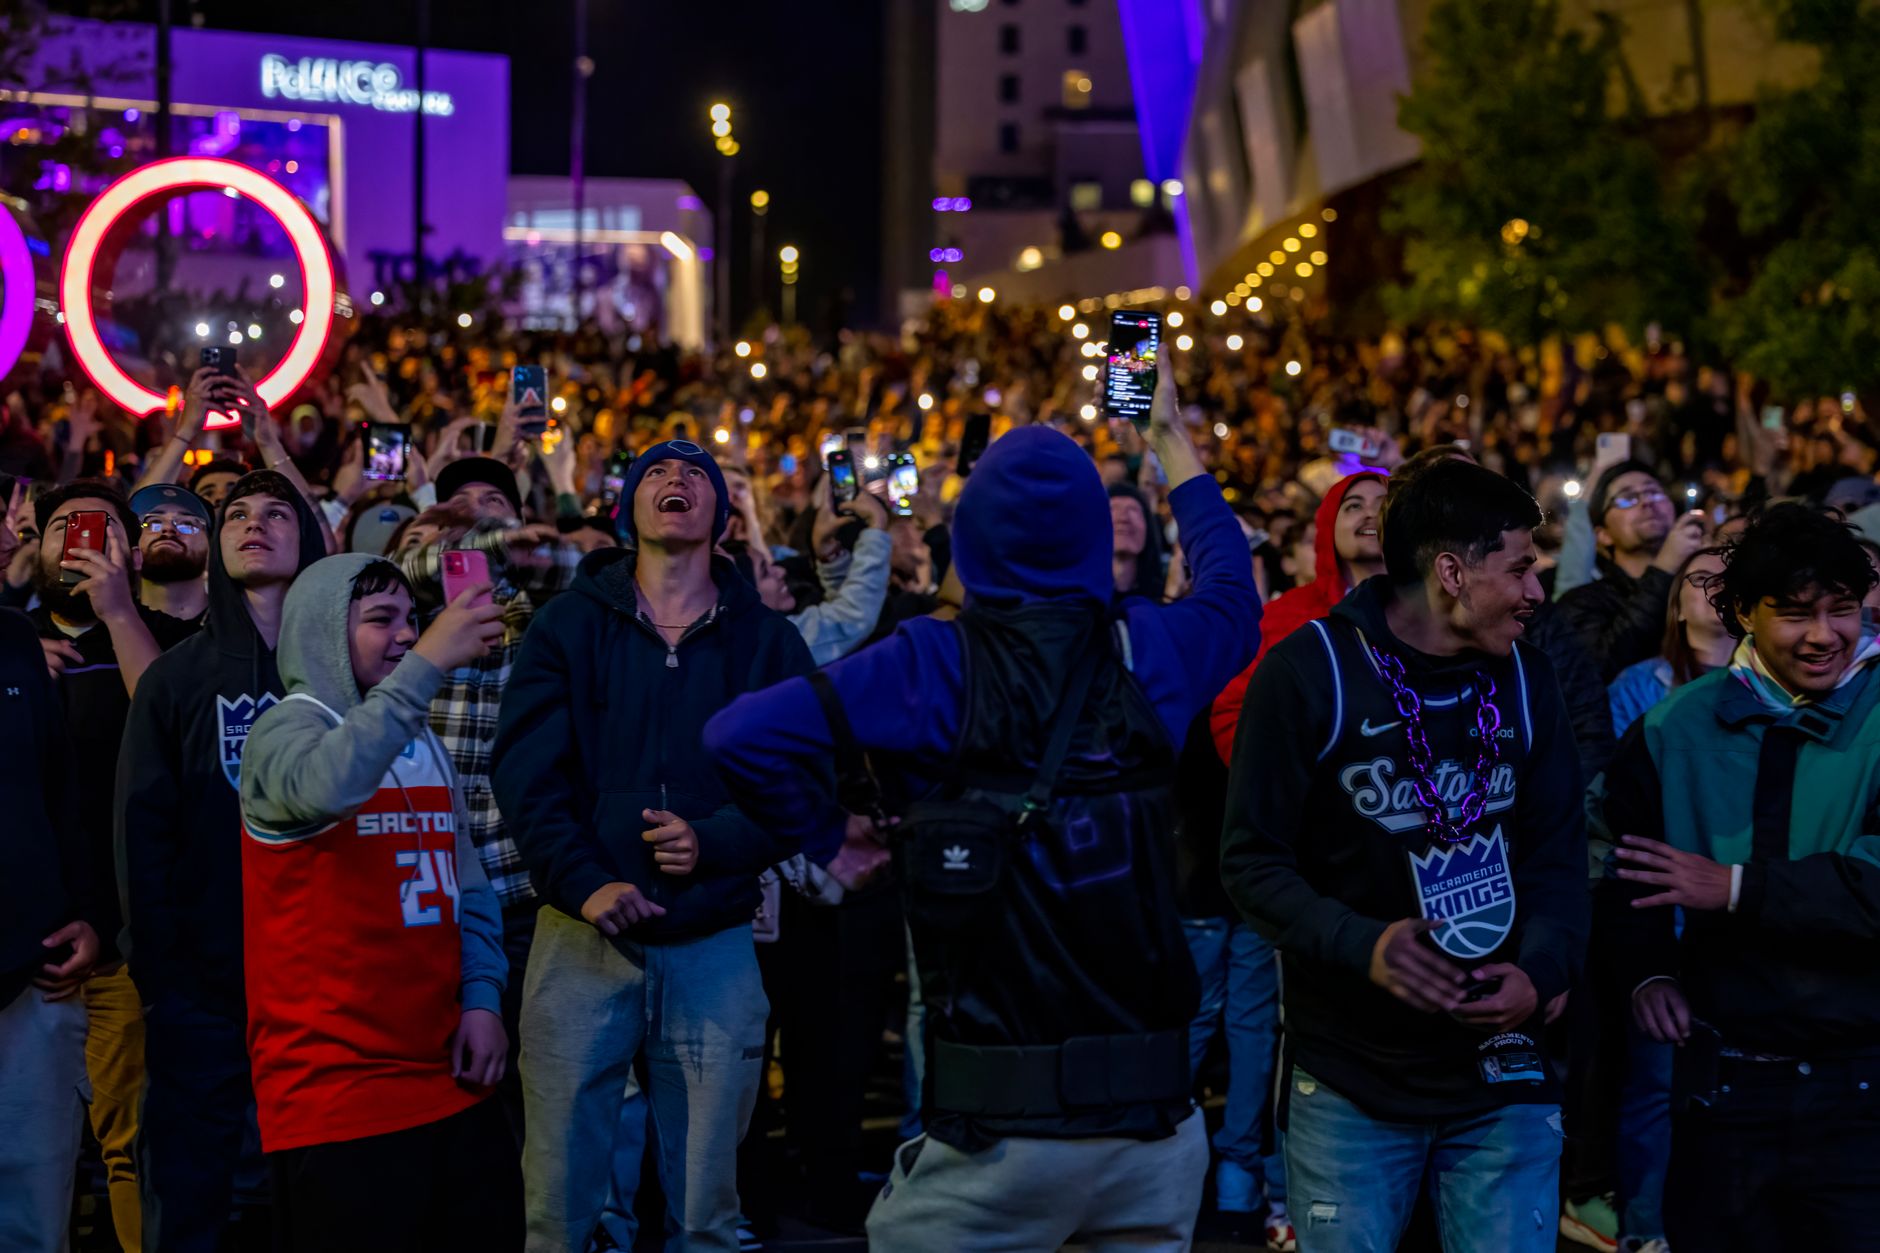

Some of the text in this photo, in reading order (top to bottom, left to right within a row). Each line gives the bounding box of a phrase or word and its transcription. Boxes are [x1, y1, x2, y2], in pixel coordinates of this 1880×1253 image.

[1339, 757, 1516, 817] Saton
[356, 811, 455, 836] SACTO
[396, 850, 460, 927] 24
[1423, 863, 1502, 896] SACRAMENTO
[1424, 877, 1511, 921] KINGS
[1478, 1032, 1535, 1051] SACRAMENTO
[1493, 1038, 1524, 1048] PROUD
